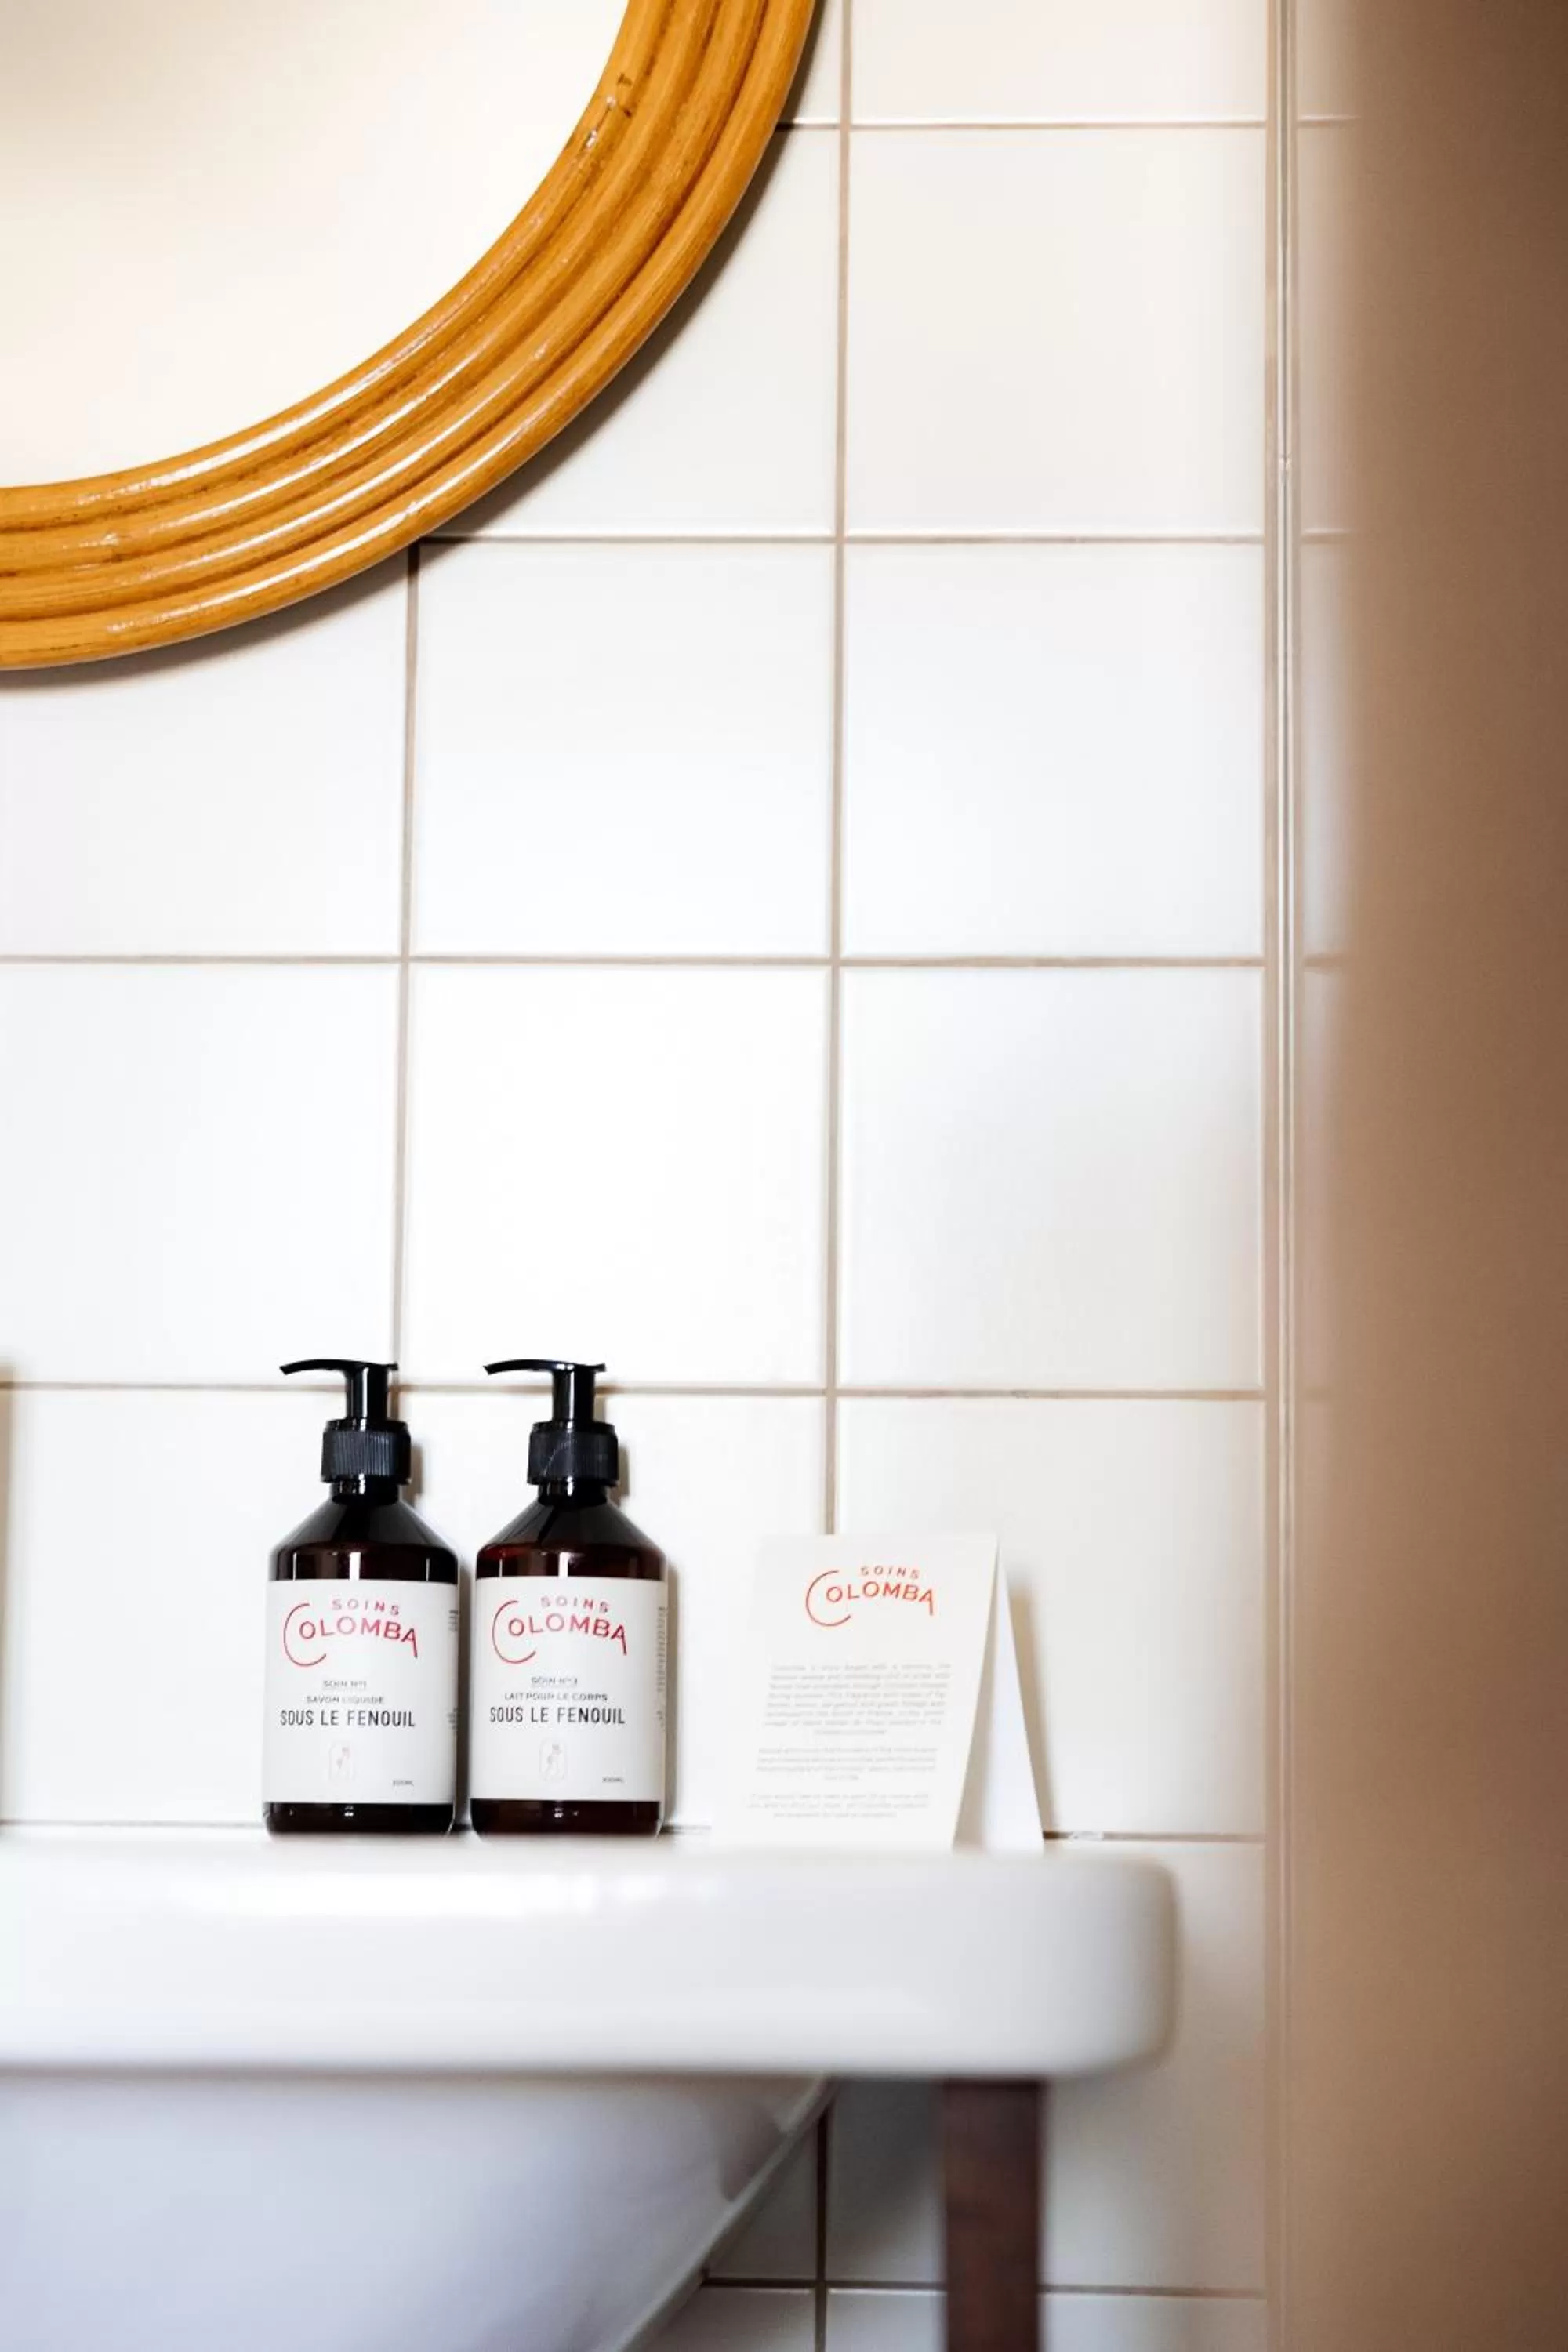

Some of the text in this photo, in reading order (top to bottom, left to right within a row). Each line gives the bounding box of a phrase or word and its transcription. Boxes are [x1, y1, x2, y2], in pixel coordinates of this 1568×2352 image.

[859, 1565, 920, 1580] SOINS
[332, 1599, 400, 1617] SOINS
[539, 1595, 609, 1614] SOINS
[805, 1570, 935, 1628] COLOMBA
[282, 1602, 419, 1668] COLOMBA
[491, 1599, 628, 1664] COLOMBA
[572, 1693, 608, 1701] CORPS
[280, 1709, 416, 1728] SOUS LE FENOUIL
[490, 1706, 626, 1725] SOUS LE FENOUIL
